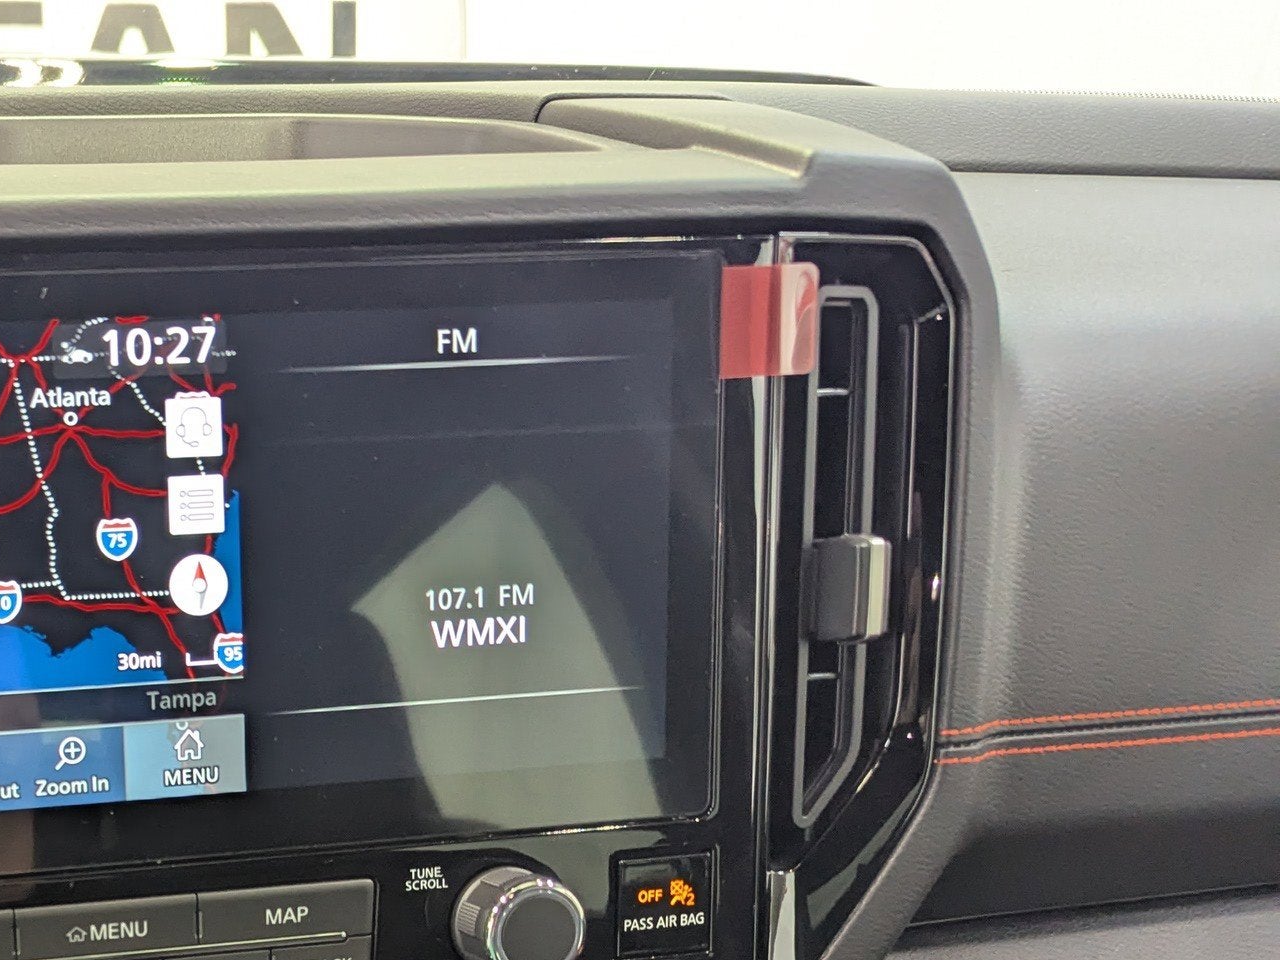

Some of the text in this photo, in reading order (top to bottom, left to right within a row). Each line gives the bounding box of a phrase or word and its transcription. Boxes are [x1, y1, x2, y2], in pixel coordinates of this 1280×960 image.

[102, 326, 216, 366] 10:27
[436, 326, 478, 355] FM
[29, 386, 112, 408] Atlanta
[107, 532, 128, 549] 75
[425, 582, 535, 612] 107.1 FM
[430, 615, 526, 649] WMXI
[117, 650, 162, 671] 30mi
[223, 646, 243, 662] 95
[146, 690, 217, 712] Tampa
[34, 776, 110, 797] Zoom In
[163, 765, 220, 787] MENU
[409, 866, 443, 880] TUNE
[405, 878, 449, 892] SCROLL
[637, 888, 663, 904] OFF
[265, 905, 309, 926] MAP
[623, 911, 705, 932] PASS AIR BAG
[89, 920, 149, 941] MENU
